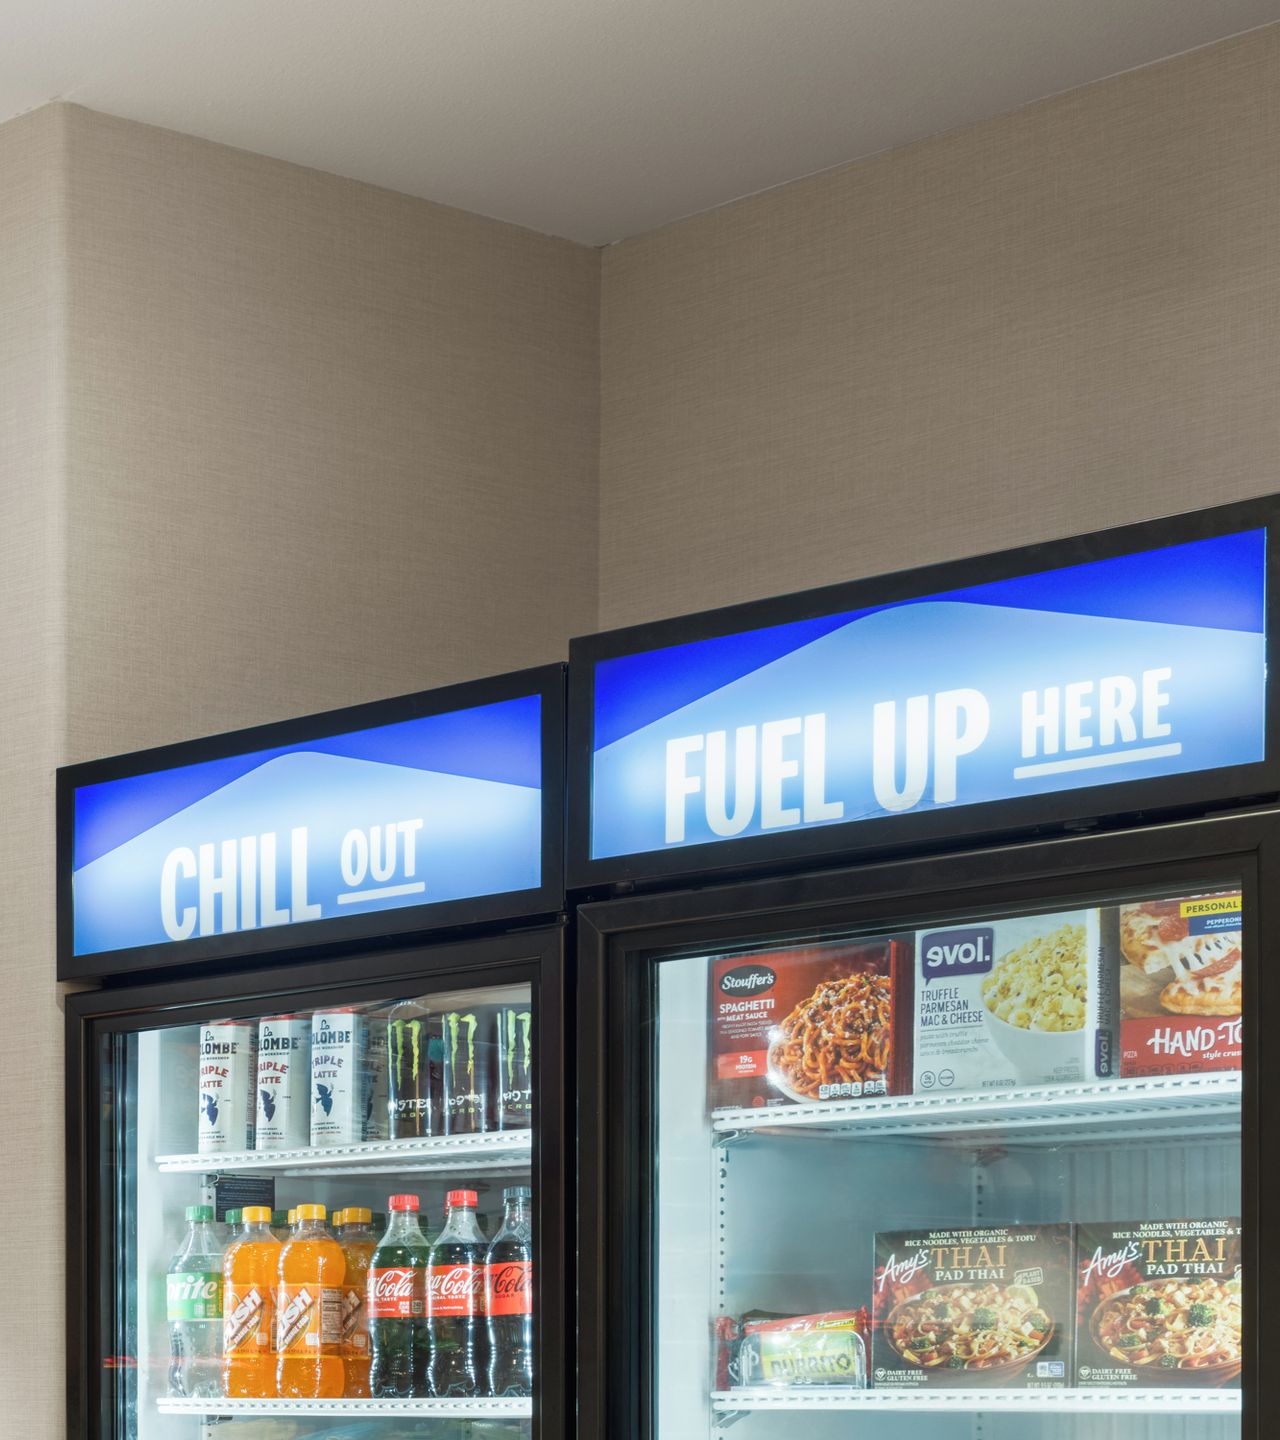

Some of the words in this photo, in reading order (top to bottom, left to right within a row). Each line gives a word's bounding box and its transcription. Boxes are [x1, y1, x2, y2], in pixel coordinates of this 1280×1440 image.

[663, 712, 844, 845] FUEL
[871, 686, 990, 812] UP
[1020, 667, 1174, 761] HERE
[159, 826, 321, 942] CHILL
[340, 819, 425, 887] OUT
[1186, 901, 1238, 914] PERSONAL
[721, 972, 775, 992] Stouffer's
[920, 987, 959, 1002] TRUFFLE
[719, 999, 775, 1014] SPAGHETTI
[920, 1000, 969, 1014] PARMESAN
[726, 1013, 743, 1022] MEAT
[744, 1011, 768, 1020] SAUCE
[920, 1014, 939, 1027] MAC
[949, 1010, 983, 1024] CHEESE
[929, 1231, 951, 1239] MADE
[952, 1230, 972, 1238] WITH
[974, 1229, 1008, 1237] ORGANIC
[960, 1236, 1006, 1245] VEGETABLES
[1015, 1235, 1037, 1243] TOFU
[877, 1248, 932, 1292] Amy's
[930, 1245, 1008, 1270] THAI
[1083, 1240, 1141, 1290] Amy's
[1144, 1238, 1227, 1264] THAI
[1147, 1263, 1179, 1276] PAD
[1184, 1261, 1224, 1275] THAI
[935, 1269, 964, 1281] PAD
[969, 1268, 1005, 1280] THAI
